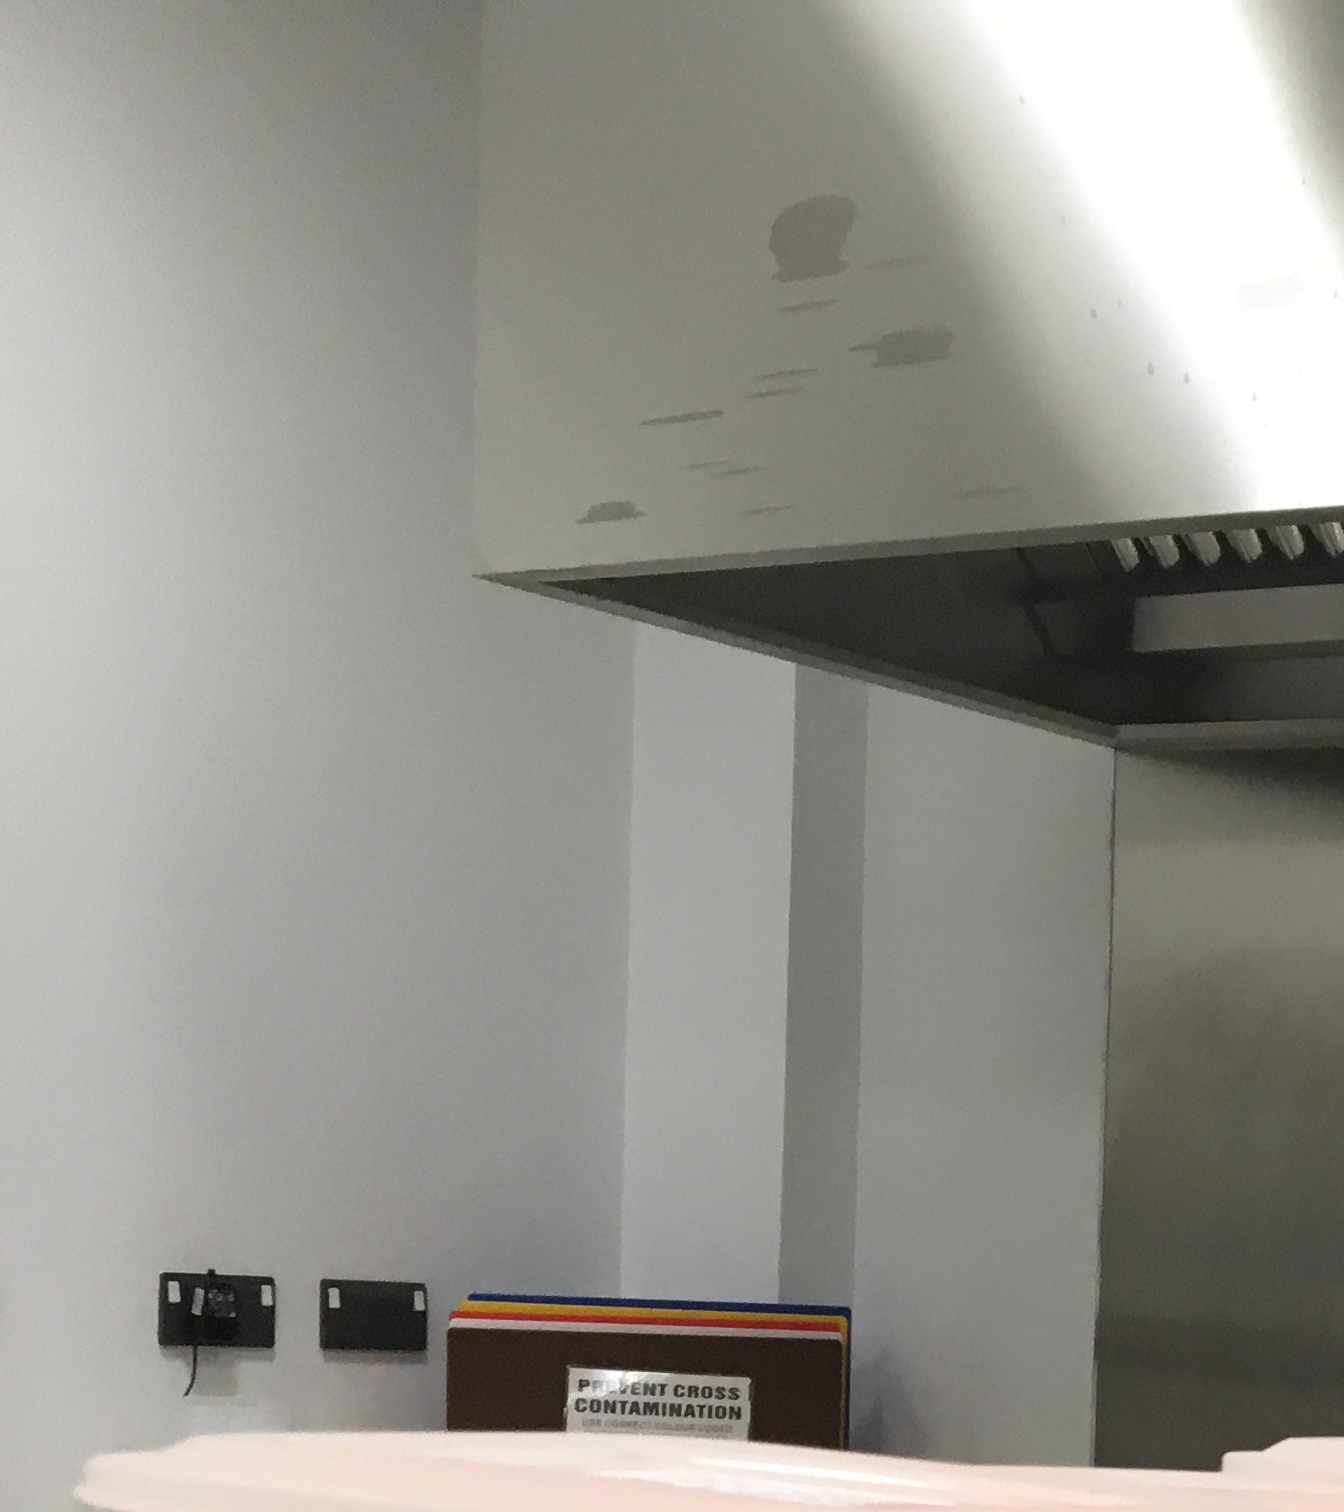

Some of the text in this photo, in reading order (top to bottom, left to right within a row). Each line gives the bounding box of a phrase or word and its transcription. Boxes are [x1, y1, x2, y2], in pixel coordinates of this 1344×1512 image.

[578, 1378, 741, 1401] PRVENT CROSS
[573, 1397, 742, 1420] CONTAMINATION
